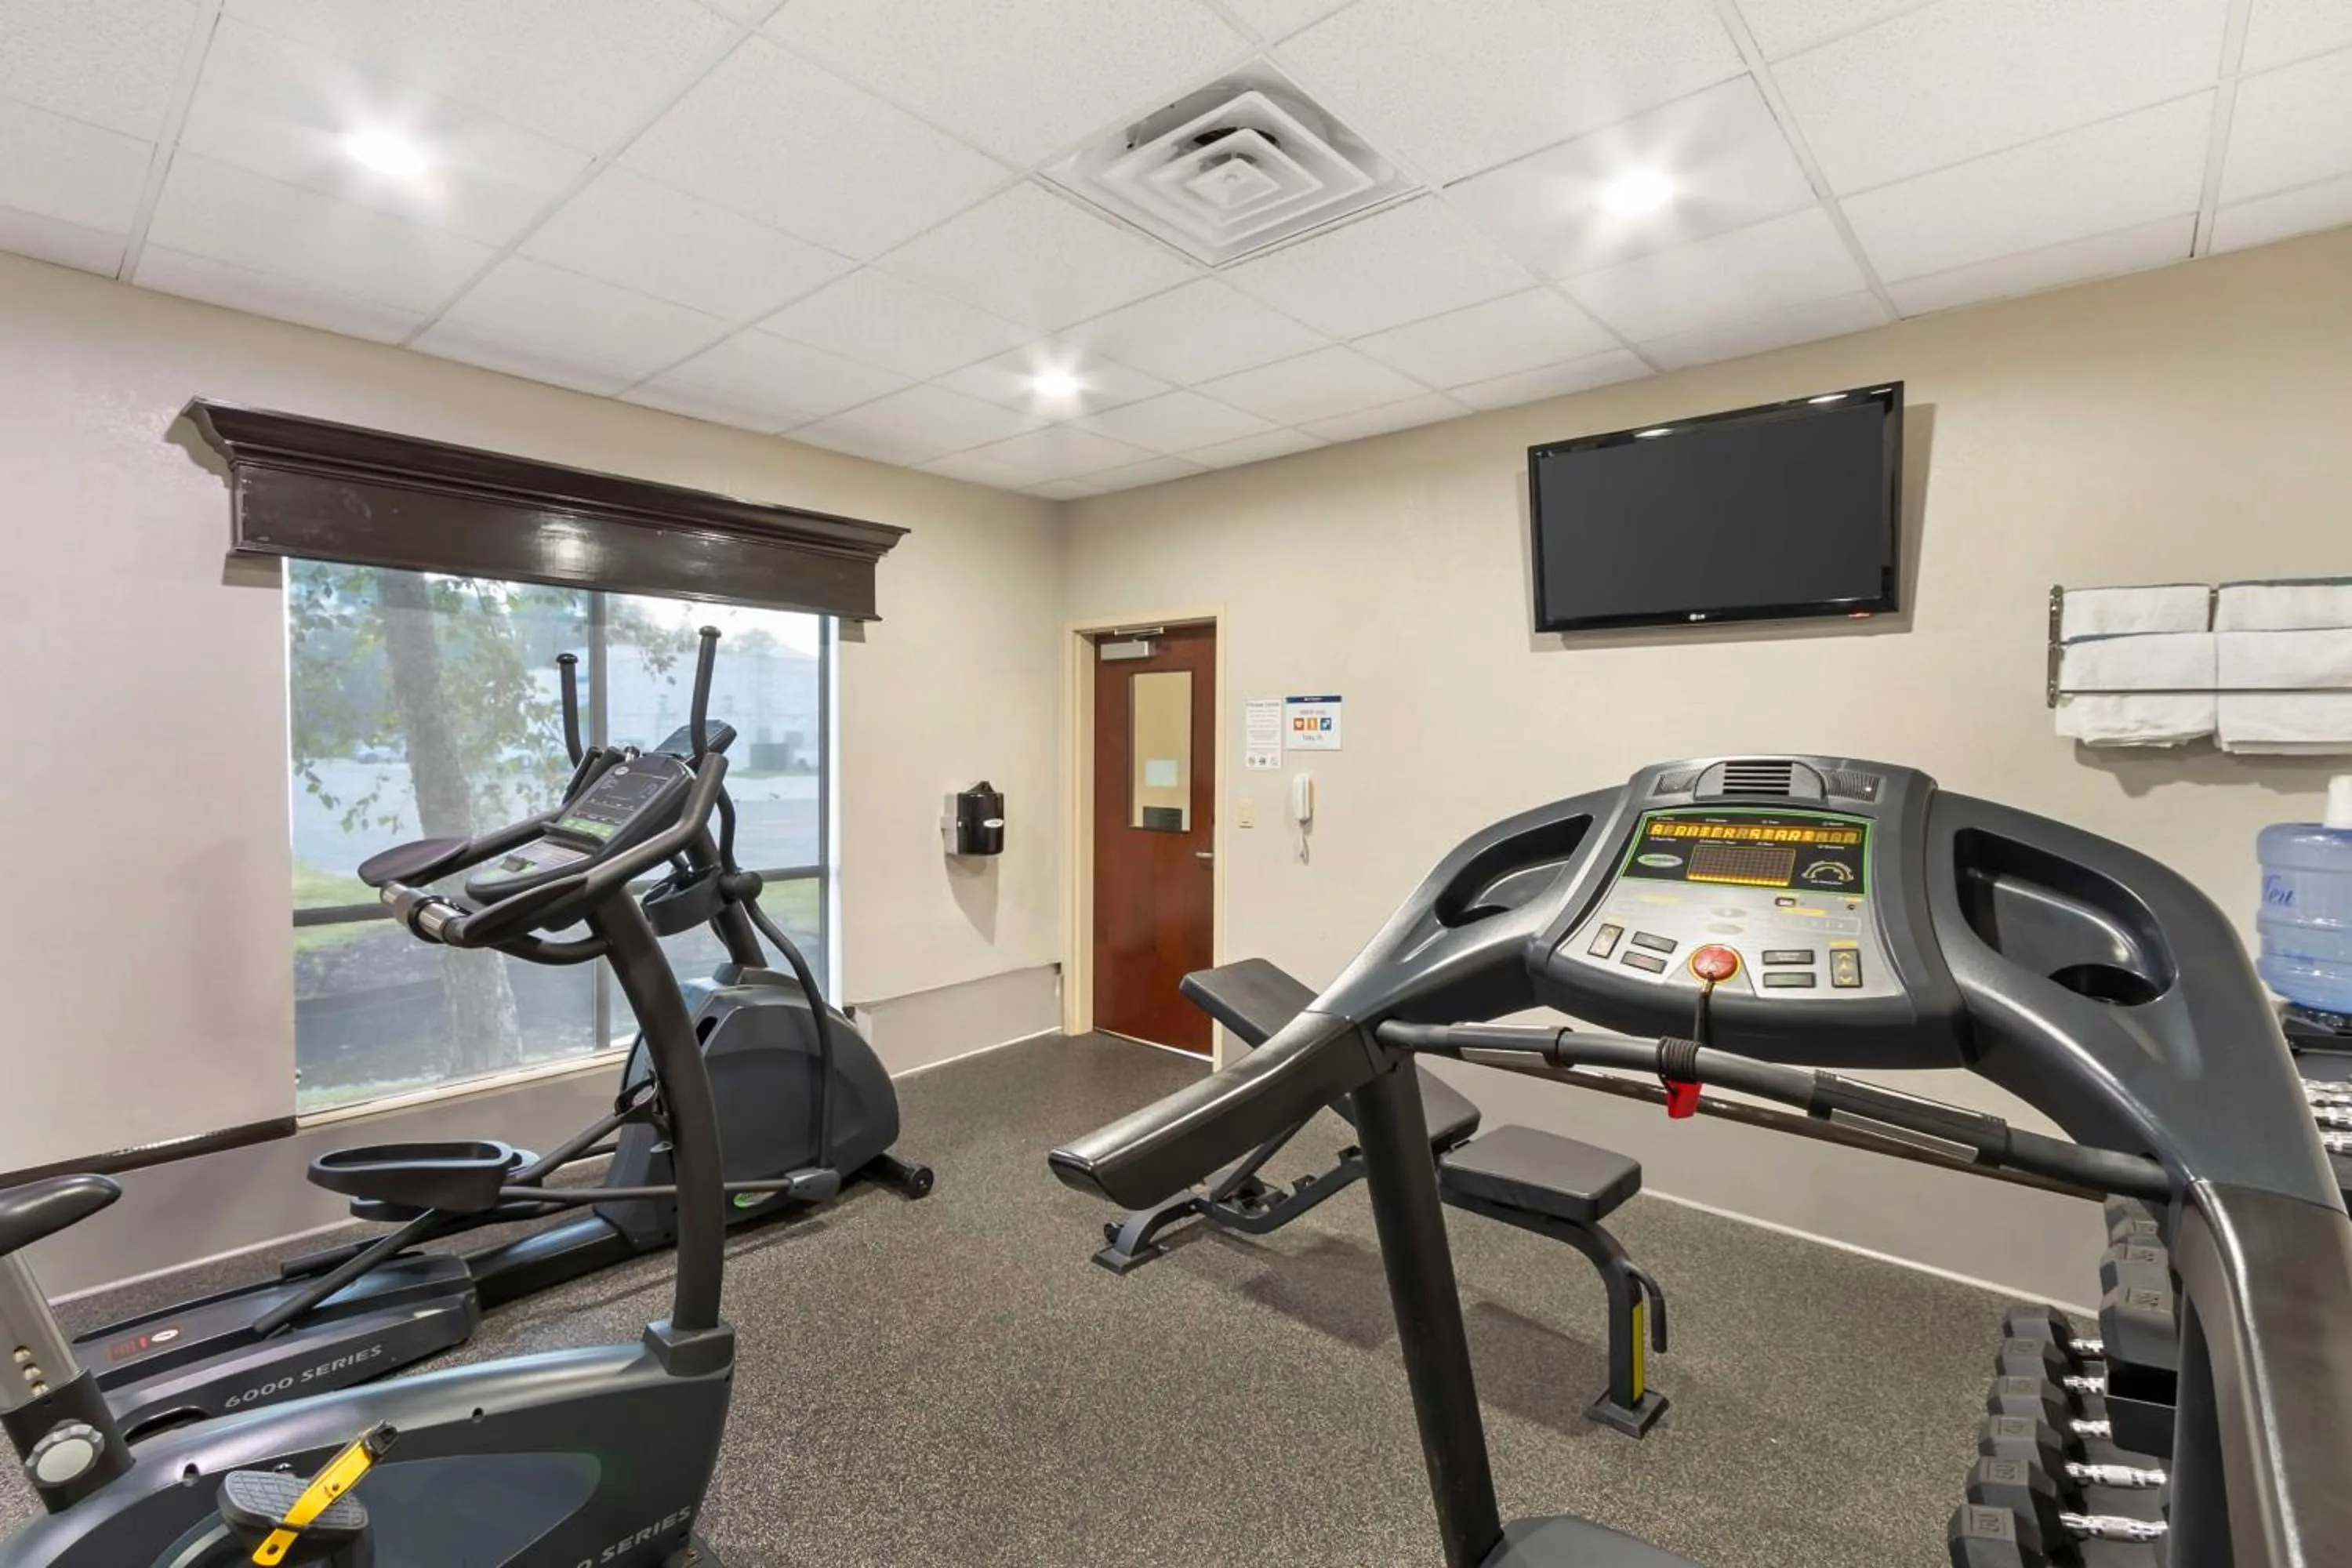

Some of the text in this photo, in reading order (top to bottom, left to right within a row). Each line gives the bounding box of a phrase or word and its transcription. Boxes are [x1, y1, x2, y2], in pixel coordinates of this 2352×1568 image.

[225, 1344, 383, 1408] 6000 SERIES
[600, 1505, 691, 1564] SERIES
